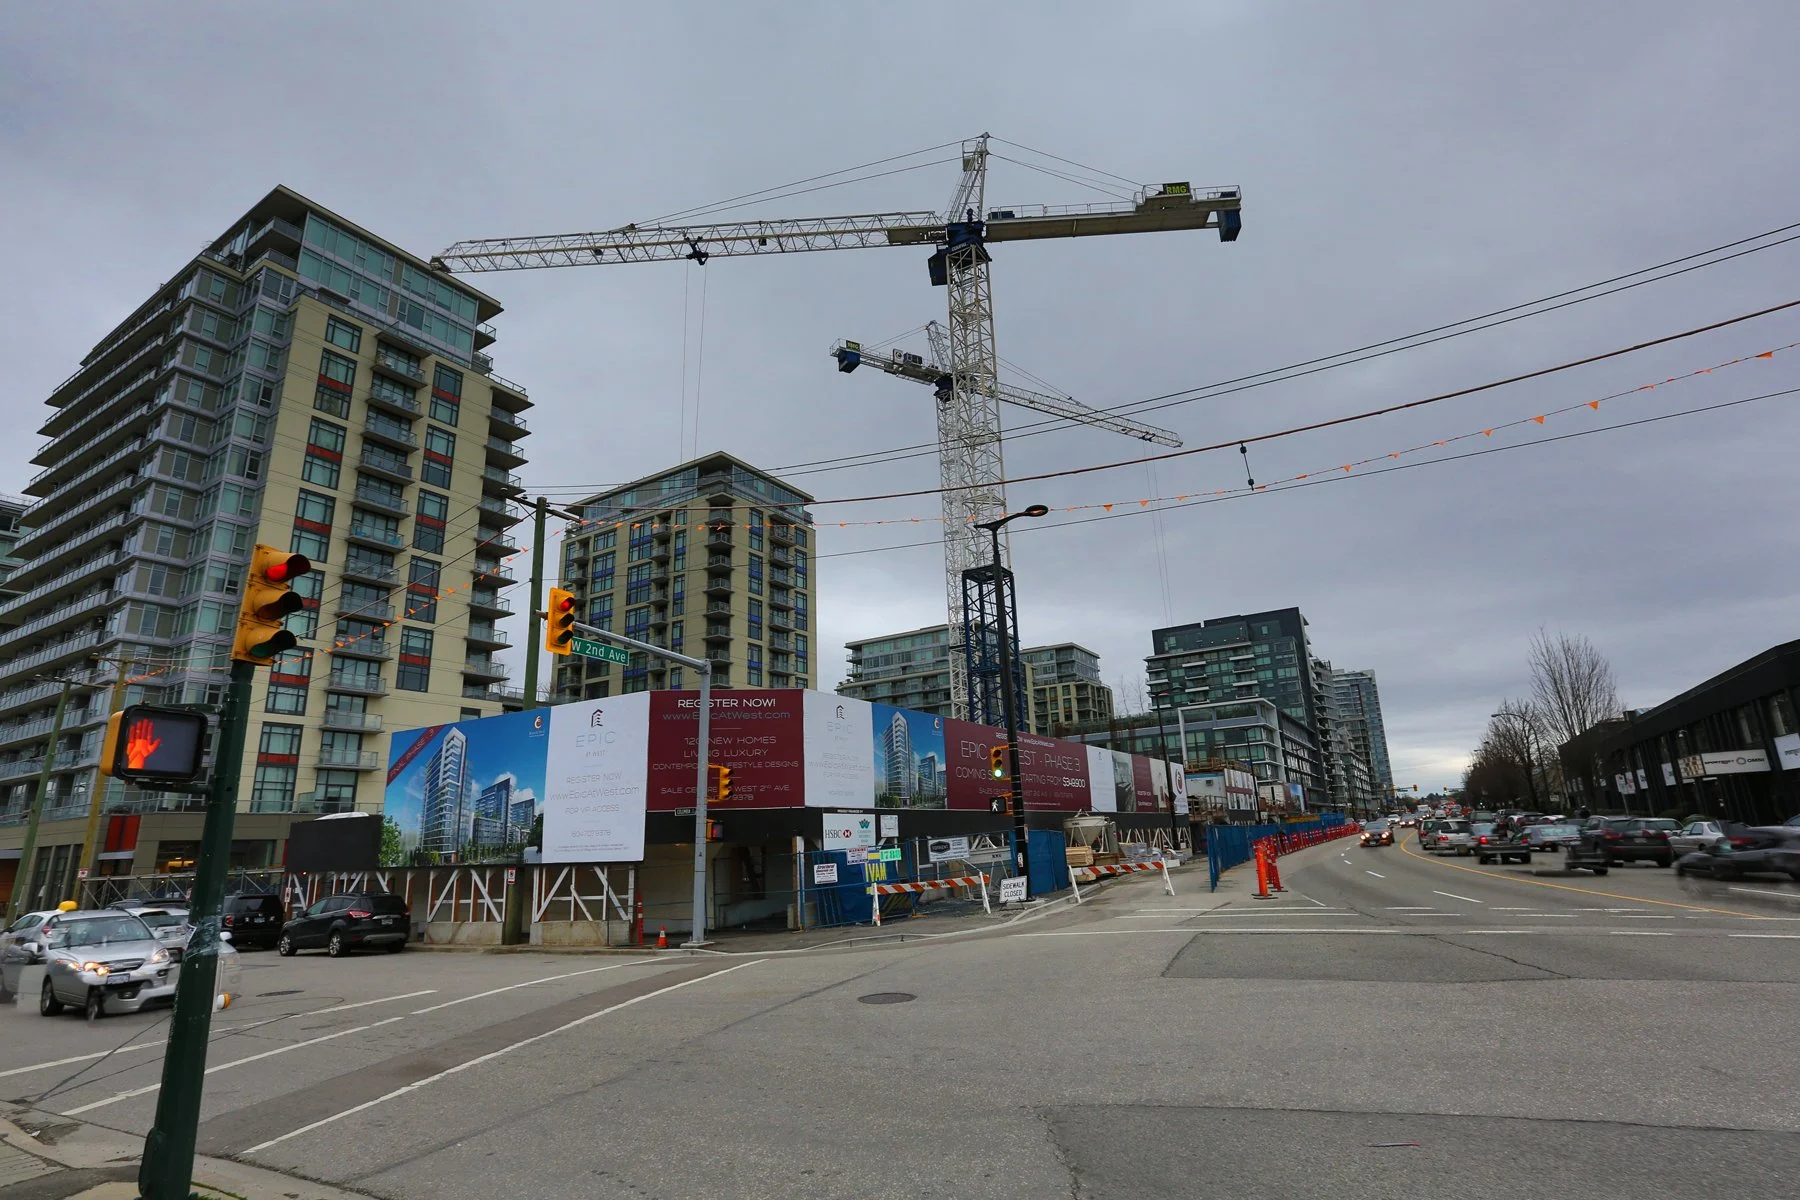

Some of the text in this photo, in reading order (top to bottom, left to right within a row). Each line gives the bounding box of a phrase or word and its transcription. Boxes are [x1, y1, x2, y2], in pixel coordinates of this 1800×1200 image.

[1166, 185, 1187, 194] RMG
[572, 641, 626, 662] W 2nd Ave
[677, 698, 776, 708] REGSTER NOW!
[576, 731, 617, 748] EPIC
[736, 736, 777, 745] HOMES
[683, 748, 769, 758] LIVNG LUXURY
[960, 740, 988, 760] EPIC
[1018, 749, 1037, 766] EST
[1044, 753, 1073, 771] PHASE
[1073, 757, 1081, 772] 3
[764, 760, 799, 769] DESIGNS
[955, 766, 987, 780] COMING
[1020, 772, 1046, 785] TARTING
[660, 787, 682, 795] SALE
[735, 785, 757, 793] WEST
[825, 829, 842, 839] HSBC
[1002, 881, 1025, 890] SIDEWALK
[1004, 889, 1023, 898] CLOSED
